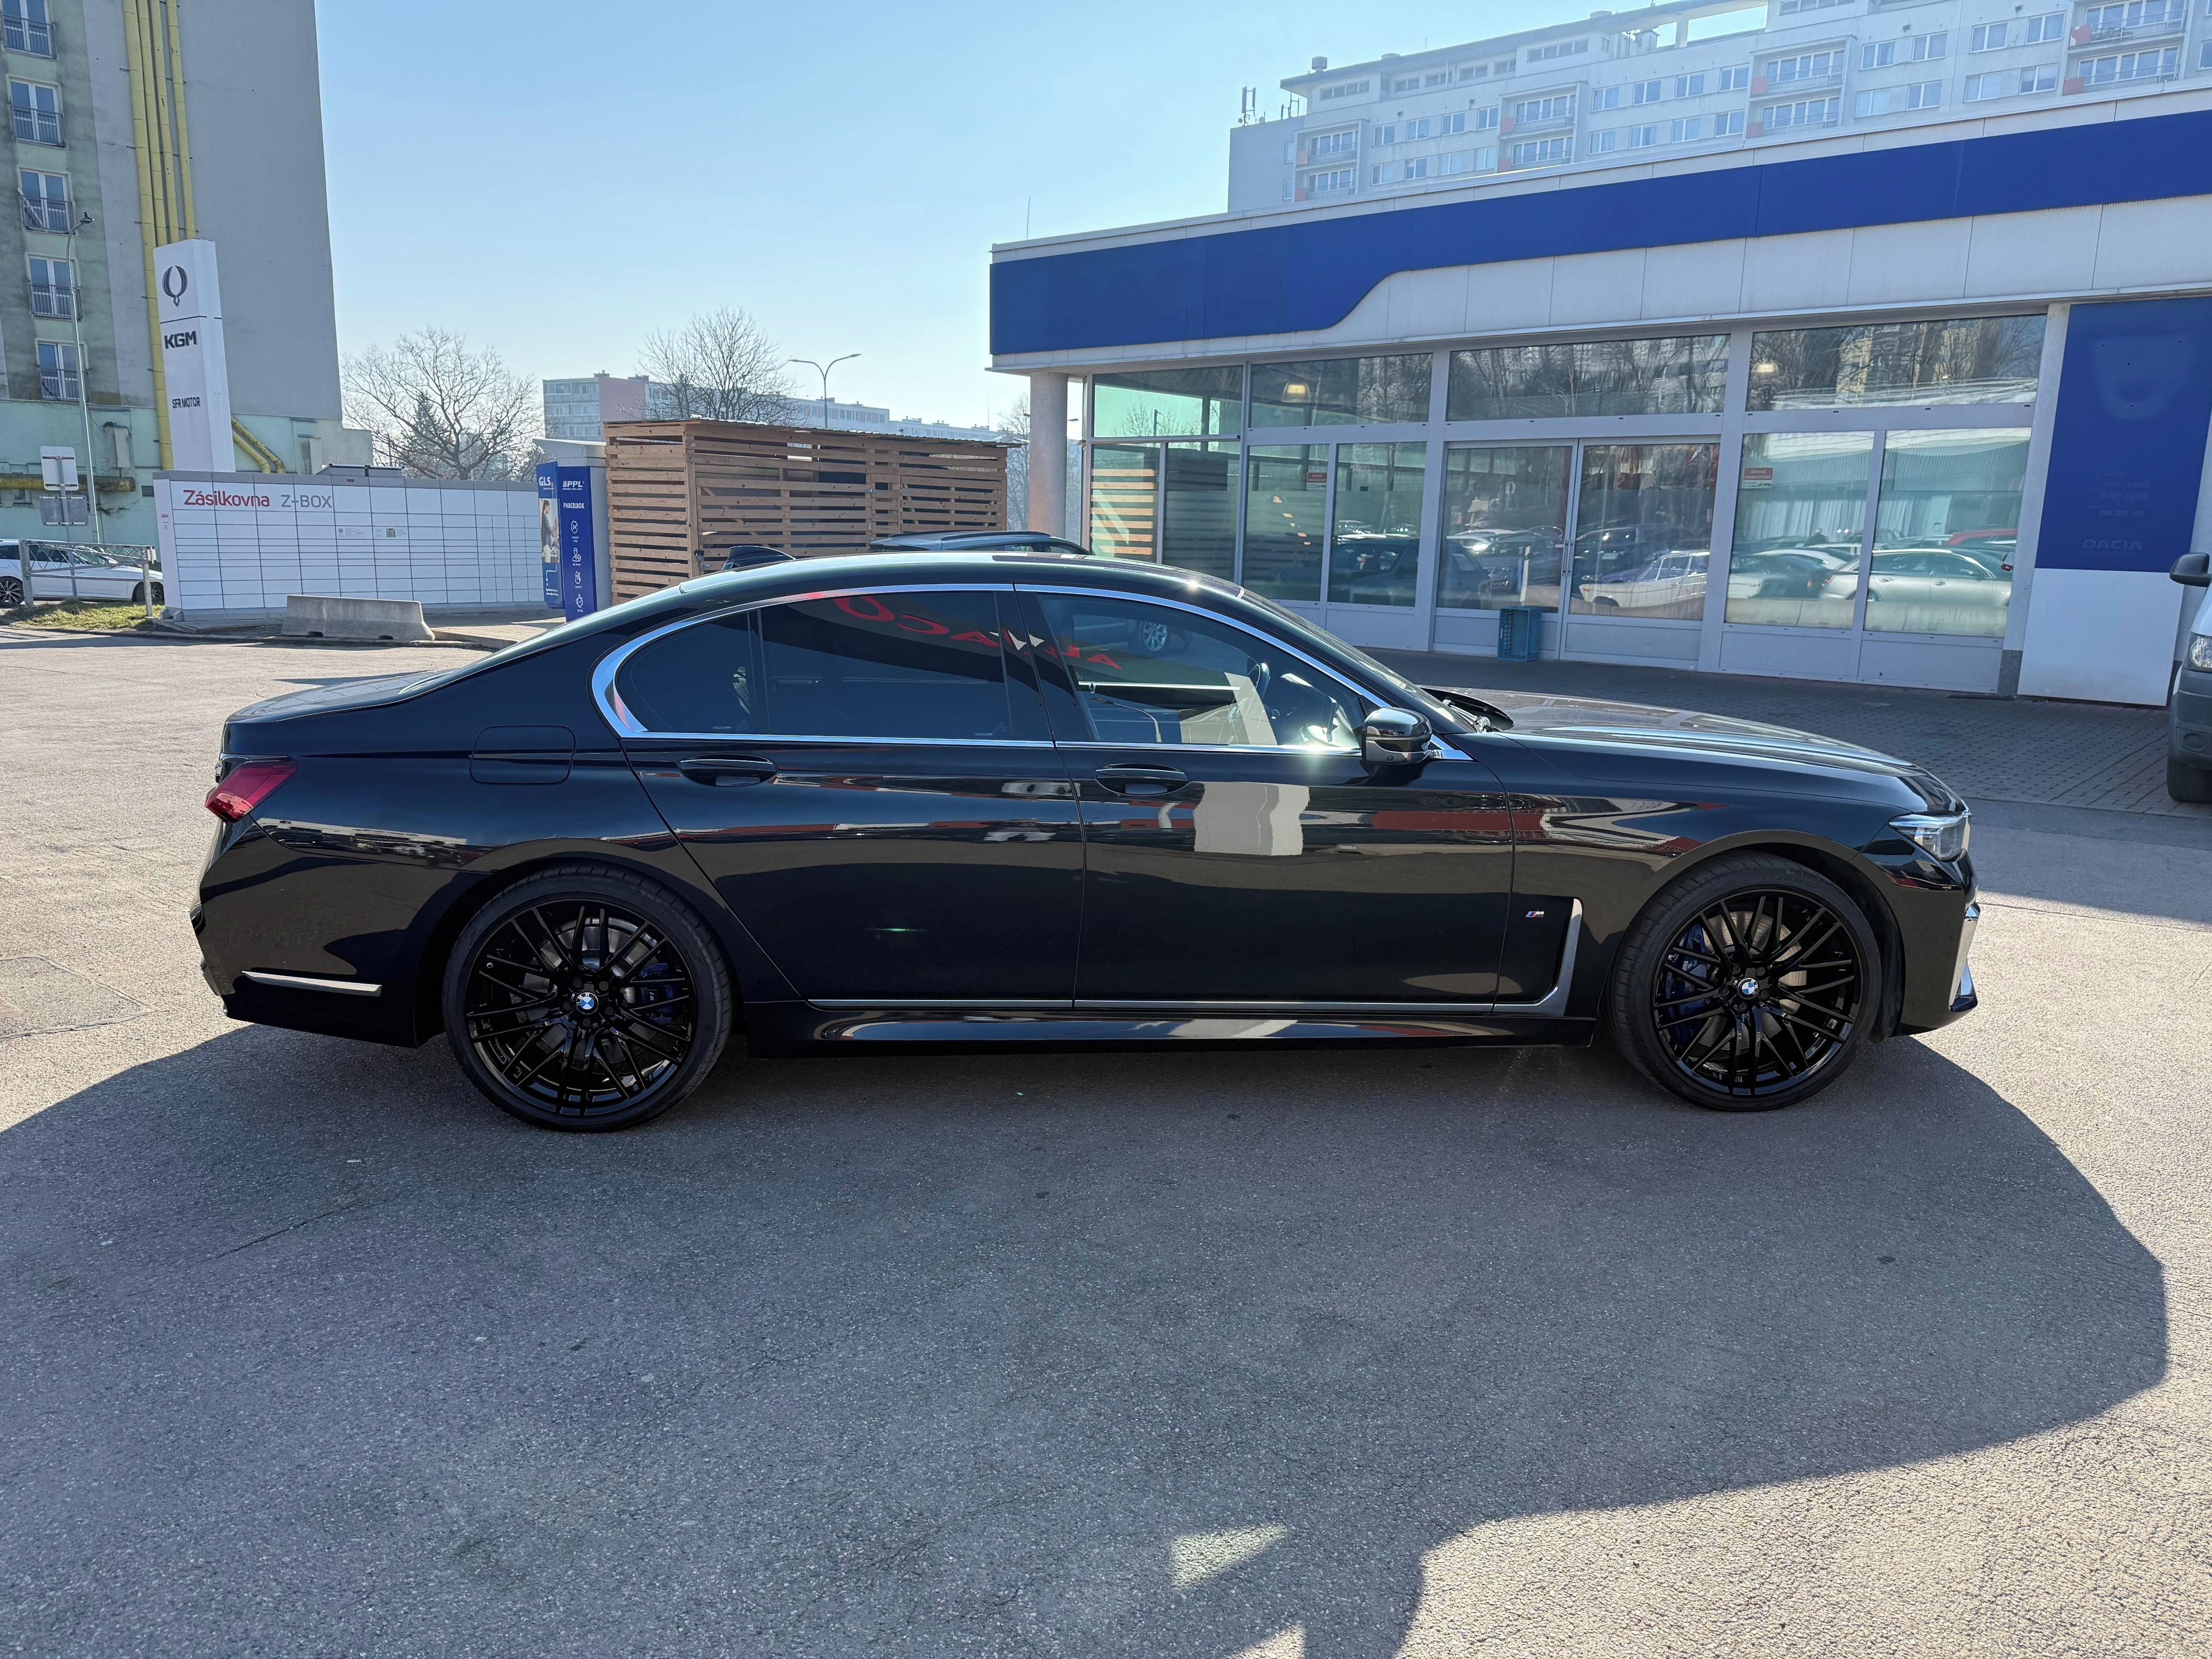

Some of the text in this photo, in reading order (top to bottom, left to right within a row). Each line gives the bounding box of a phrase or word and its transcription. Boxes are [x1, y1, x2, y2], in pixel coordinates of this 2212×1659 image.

[164, 331, 198, 349] KGM
[172, 397, 200, 409] SFR MOTOR
[538, 476, 551, 487] GLS
[183, 489, 333, 508] Zásilkovna Z-BOX
[2083, 539, 2142, 550] DACIA
